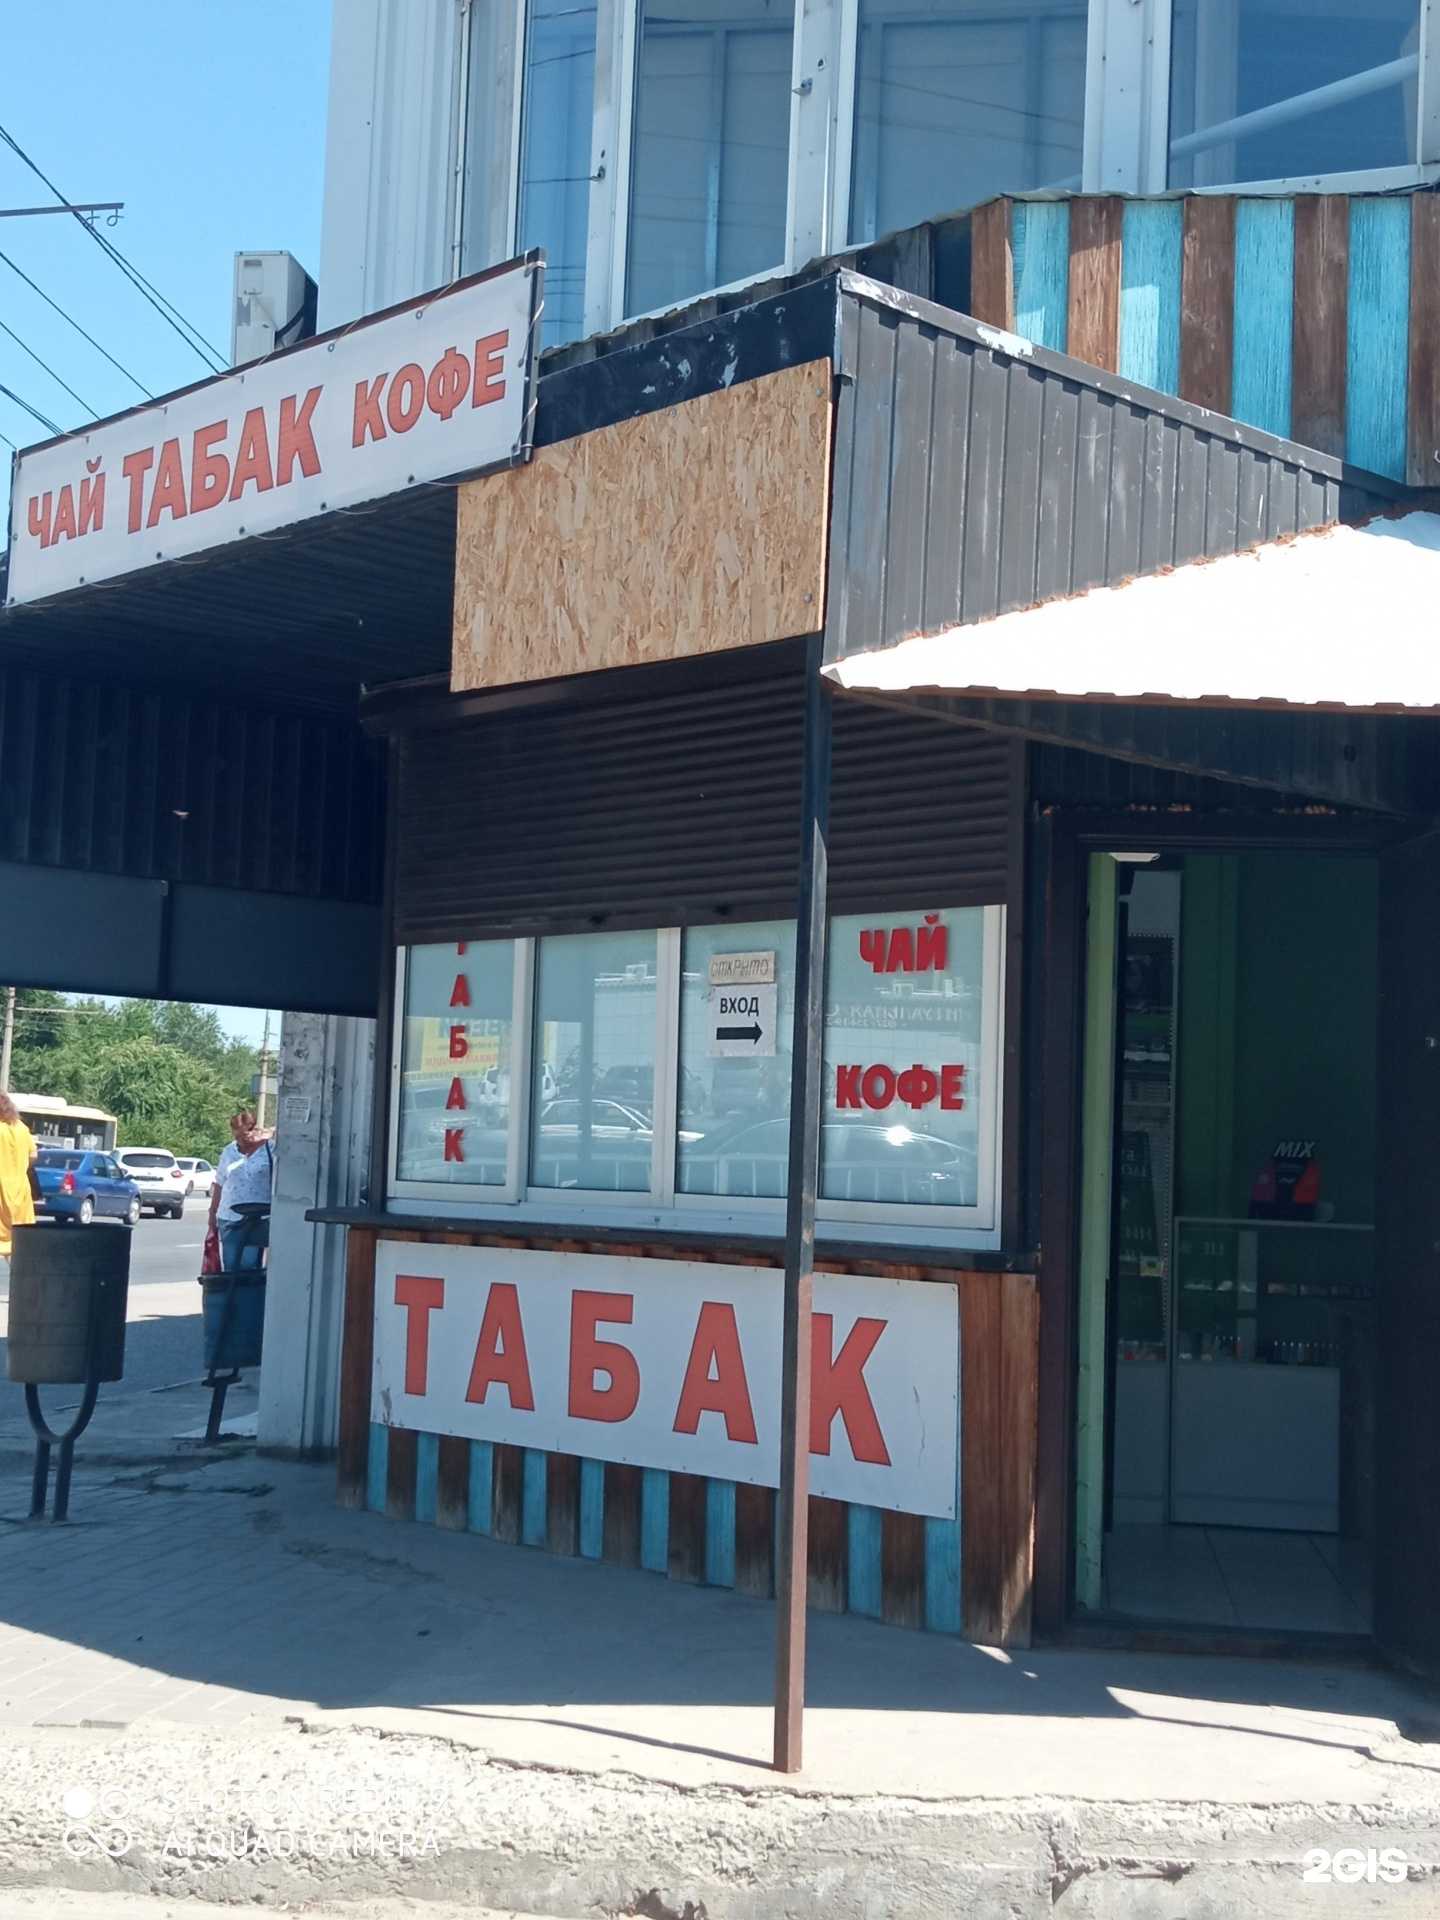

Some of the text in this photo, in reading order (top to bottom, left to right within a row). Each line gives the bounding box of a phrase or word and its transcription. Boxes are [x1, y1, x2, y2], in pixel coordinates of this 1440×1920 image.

[28, 329, 509, 549] ЧАЙ ТАБАК КОФЕ
[859, 912, 947, 973] ЧАЙ
[720, 996, 760, 1017] ВХОД
[836, 1063, 964, 1111] КОФЕ
[1273, 1141, 1315, 1158] MIX
[394, 1274, 892, 1467] ТАБАК
